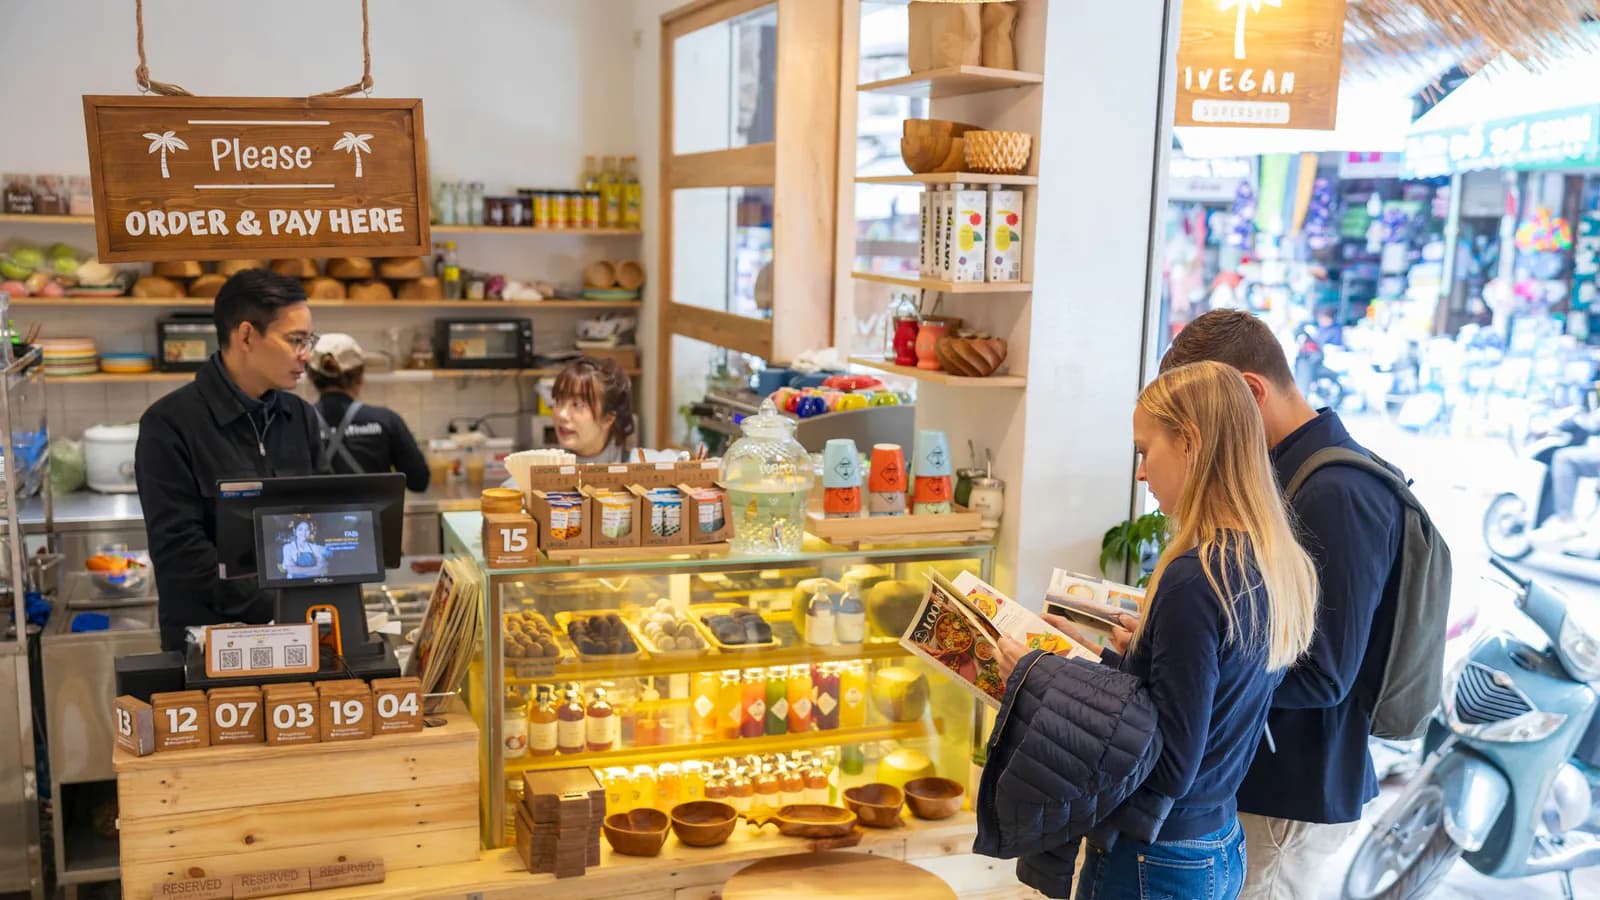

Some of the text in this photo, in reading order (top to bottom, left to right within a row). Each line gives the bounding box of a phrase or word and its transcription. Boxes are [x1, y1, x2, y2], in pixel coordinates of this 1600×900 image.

[1184, 66, 1296, 95] IVEGAN
[1202, 104, 1281, 118] SUPERSHOP
[211, 137, 313, 172] Please
[125, 207, 405, 237] ORDER & PAY HERE
[944, 207, 952, 271] OATSIDE
[500, 528, 529, 553] 15
[214, 702, 257, 728] 07
[272, 703, 315, 729] 03
[329, 700, 364, 725] 19
[376, 693, 419, 718] 04
[116, 708, 133, 736] 13
[165, 707, 199, 733] 12
[241, 870, 299, 888] RESERVED
[320, 860, 376, 878] RESERVED
[162, 879, 223, 895] RESERVED
